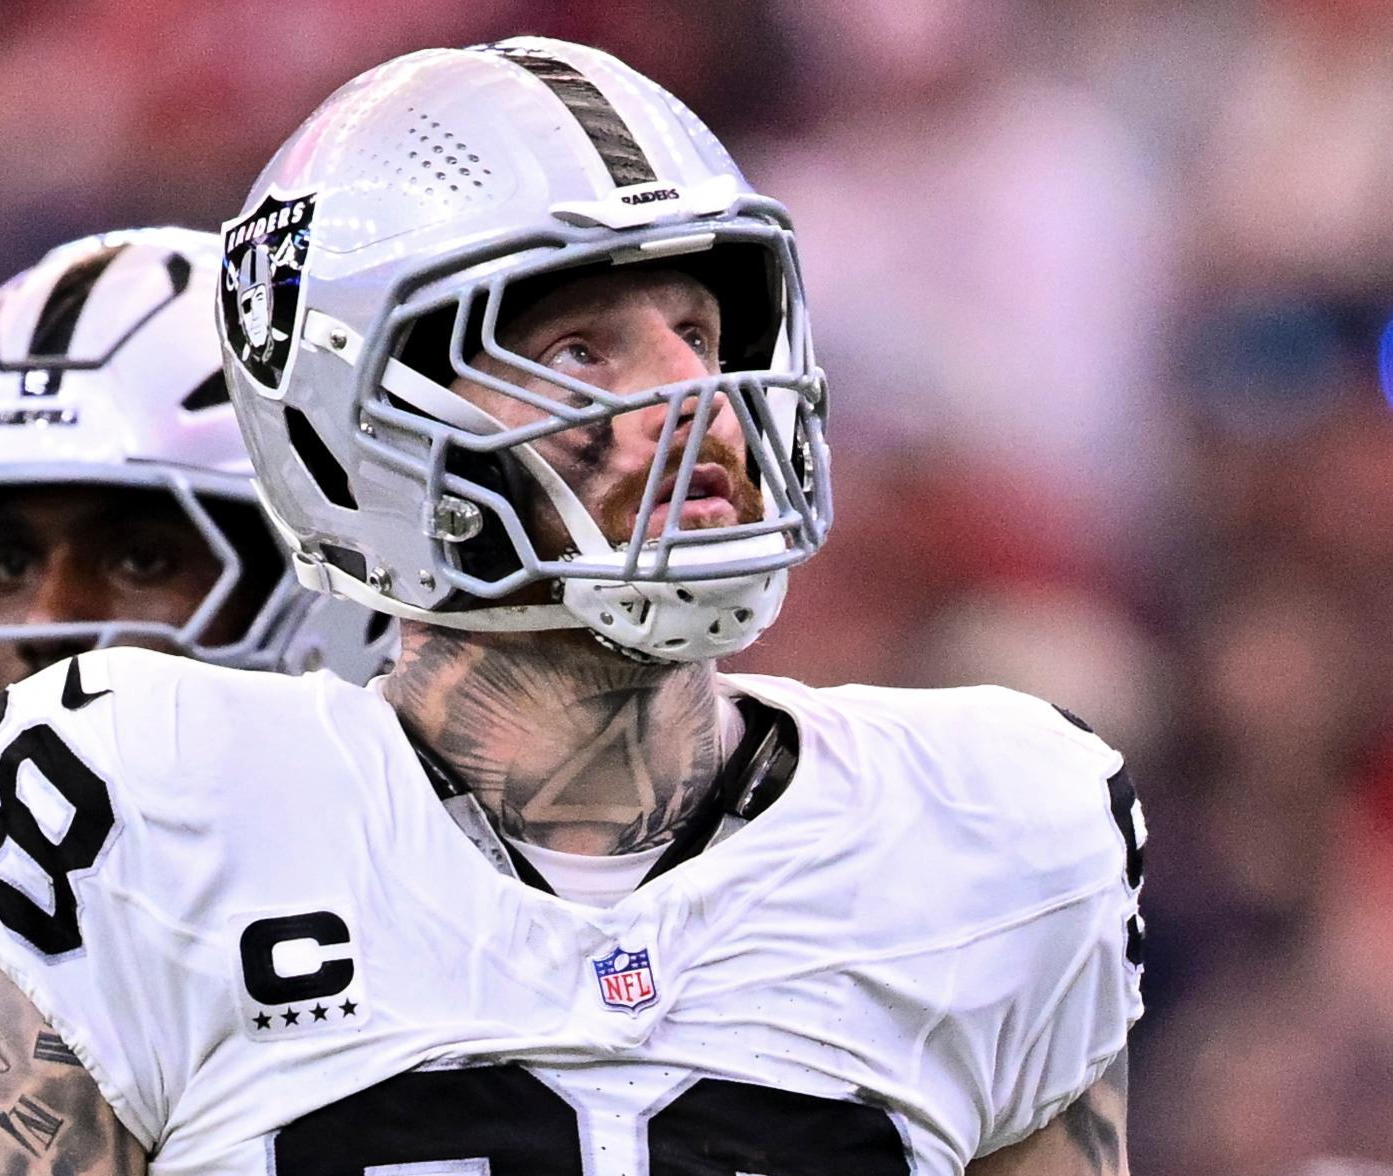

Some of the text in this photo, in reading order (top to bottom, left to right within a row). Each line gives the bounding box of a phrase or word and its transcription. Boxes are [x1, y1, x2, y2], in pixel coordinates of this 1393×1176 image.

[621, 188, 680, 205] RAIDERS
[239, 910, 354, 1006] C
[603, 971, 652, 1003] NFL
